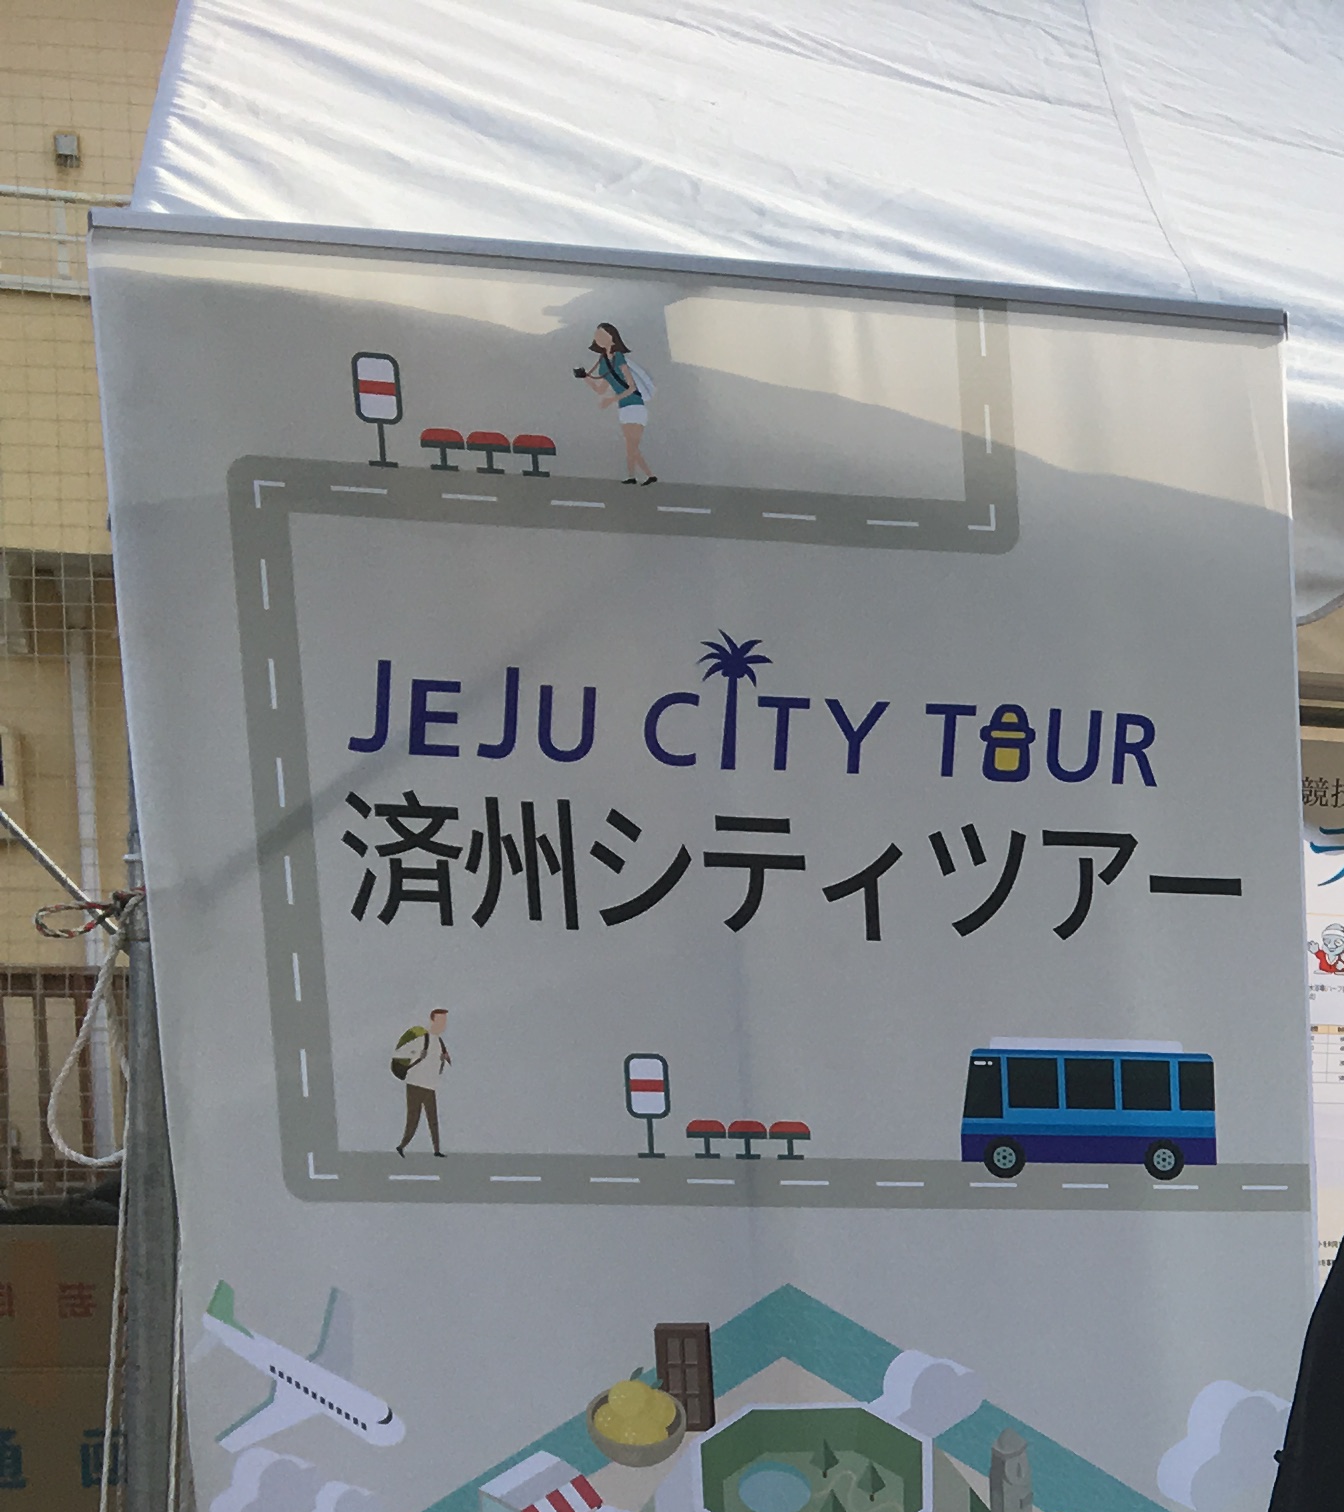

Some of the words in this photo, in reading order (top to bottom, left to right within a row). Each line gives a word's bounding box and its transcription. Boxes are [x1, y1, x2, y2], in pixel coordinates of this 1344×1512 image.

[348, 659, 597, 763] JEJU
[643, 655, 890, 775] CITY
[925, 702, 1159, 788] TOUR
[341, 788, 1243, 943] 済州シティツアー
